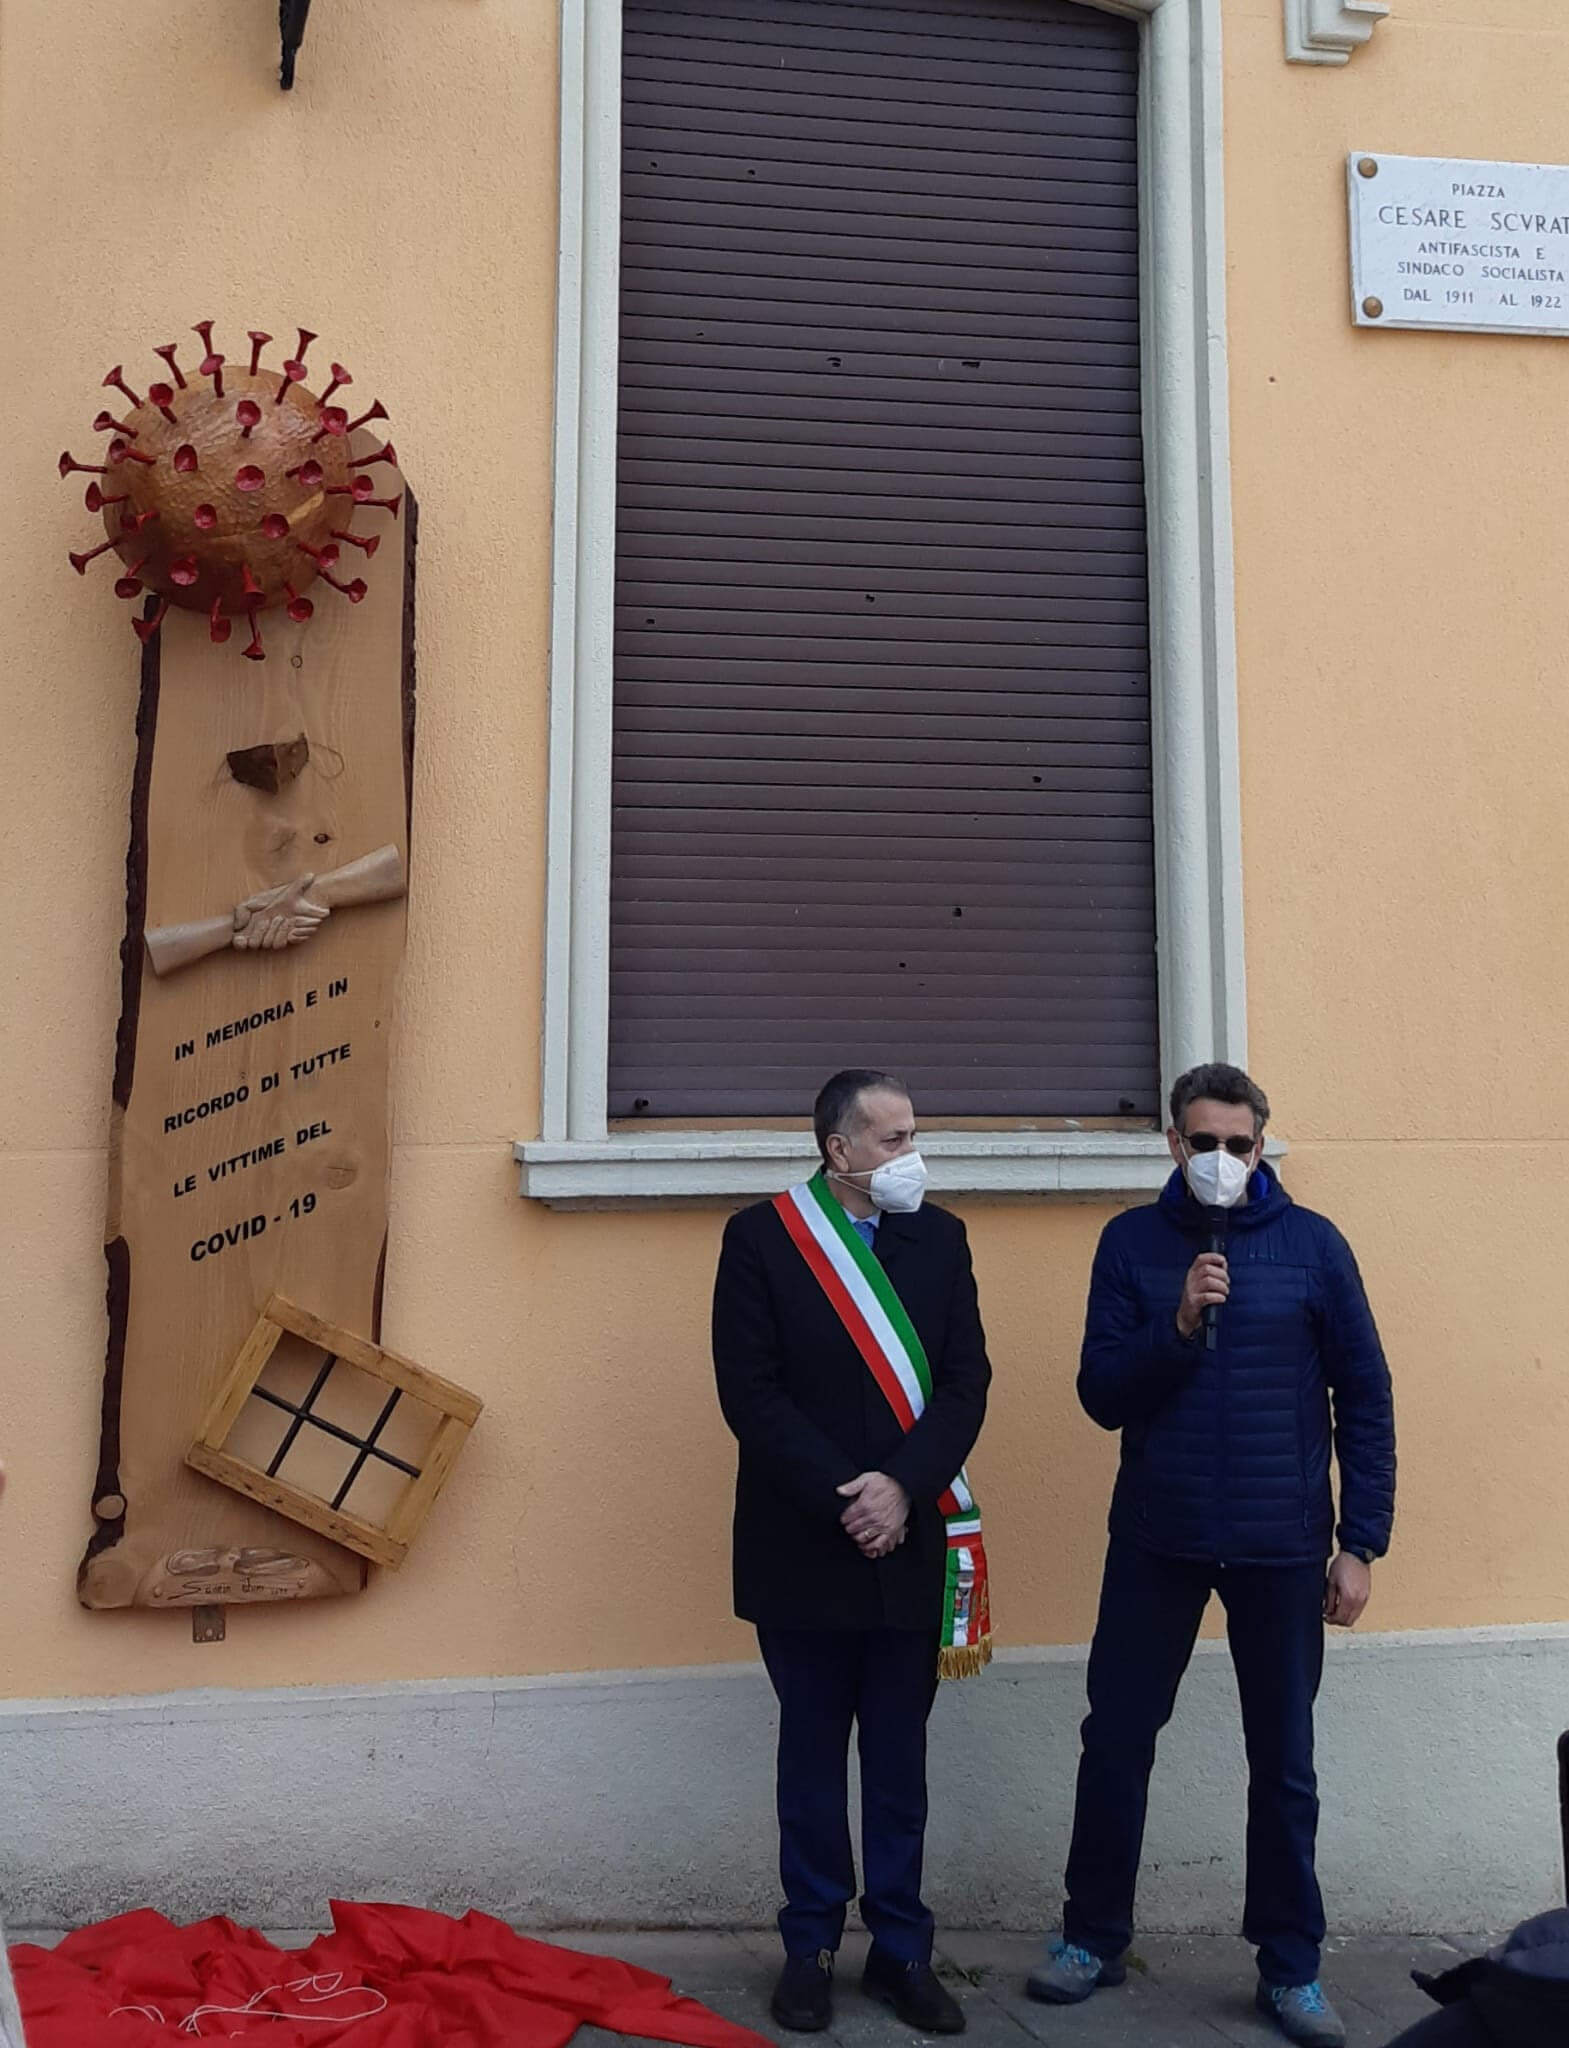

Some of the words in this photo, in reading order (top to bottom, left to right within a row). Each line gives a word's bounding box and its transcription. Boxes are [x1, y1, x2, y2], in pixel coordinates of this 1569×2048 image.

[1451, 183, 1506, 199] PIAZZA
[1378, 205, 1467, 229] CESARE
[1417, 242, 1521, 259] ANTIFASCISTA
[1536, 247, 1545, 260] E
[1397, 261, 1465, 277] SINDACO
[1481, 266, 1565, 282] SOCIALISTA
[1403, 288, 1432, 302] DAL
[1445, 291, 1474, 304] 1911
[1499, 294, 1518, 306] AL
[1531, 295, 1562, 309] 1922
[173, 1039, 195, 1061] IN
[206, 1000, 295, 1049] MEMORIA
[305, 990, 318, 1008] E
[328, 977, 348, 999] IN
[163, 1085, 249, 1134] RICORDO
[261, 1072, 279, 1094] DI
[290, 1043, 351, 1080] TUTTE
[173, 1175, 197, 1198] LE
[208, 1137, 285, 1182] VITTIME
[296, 1120, 332, 1146] DEL
[190, 1214, 266, 1262] COVID
[289, 1192, 317, 1219] 19
